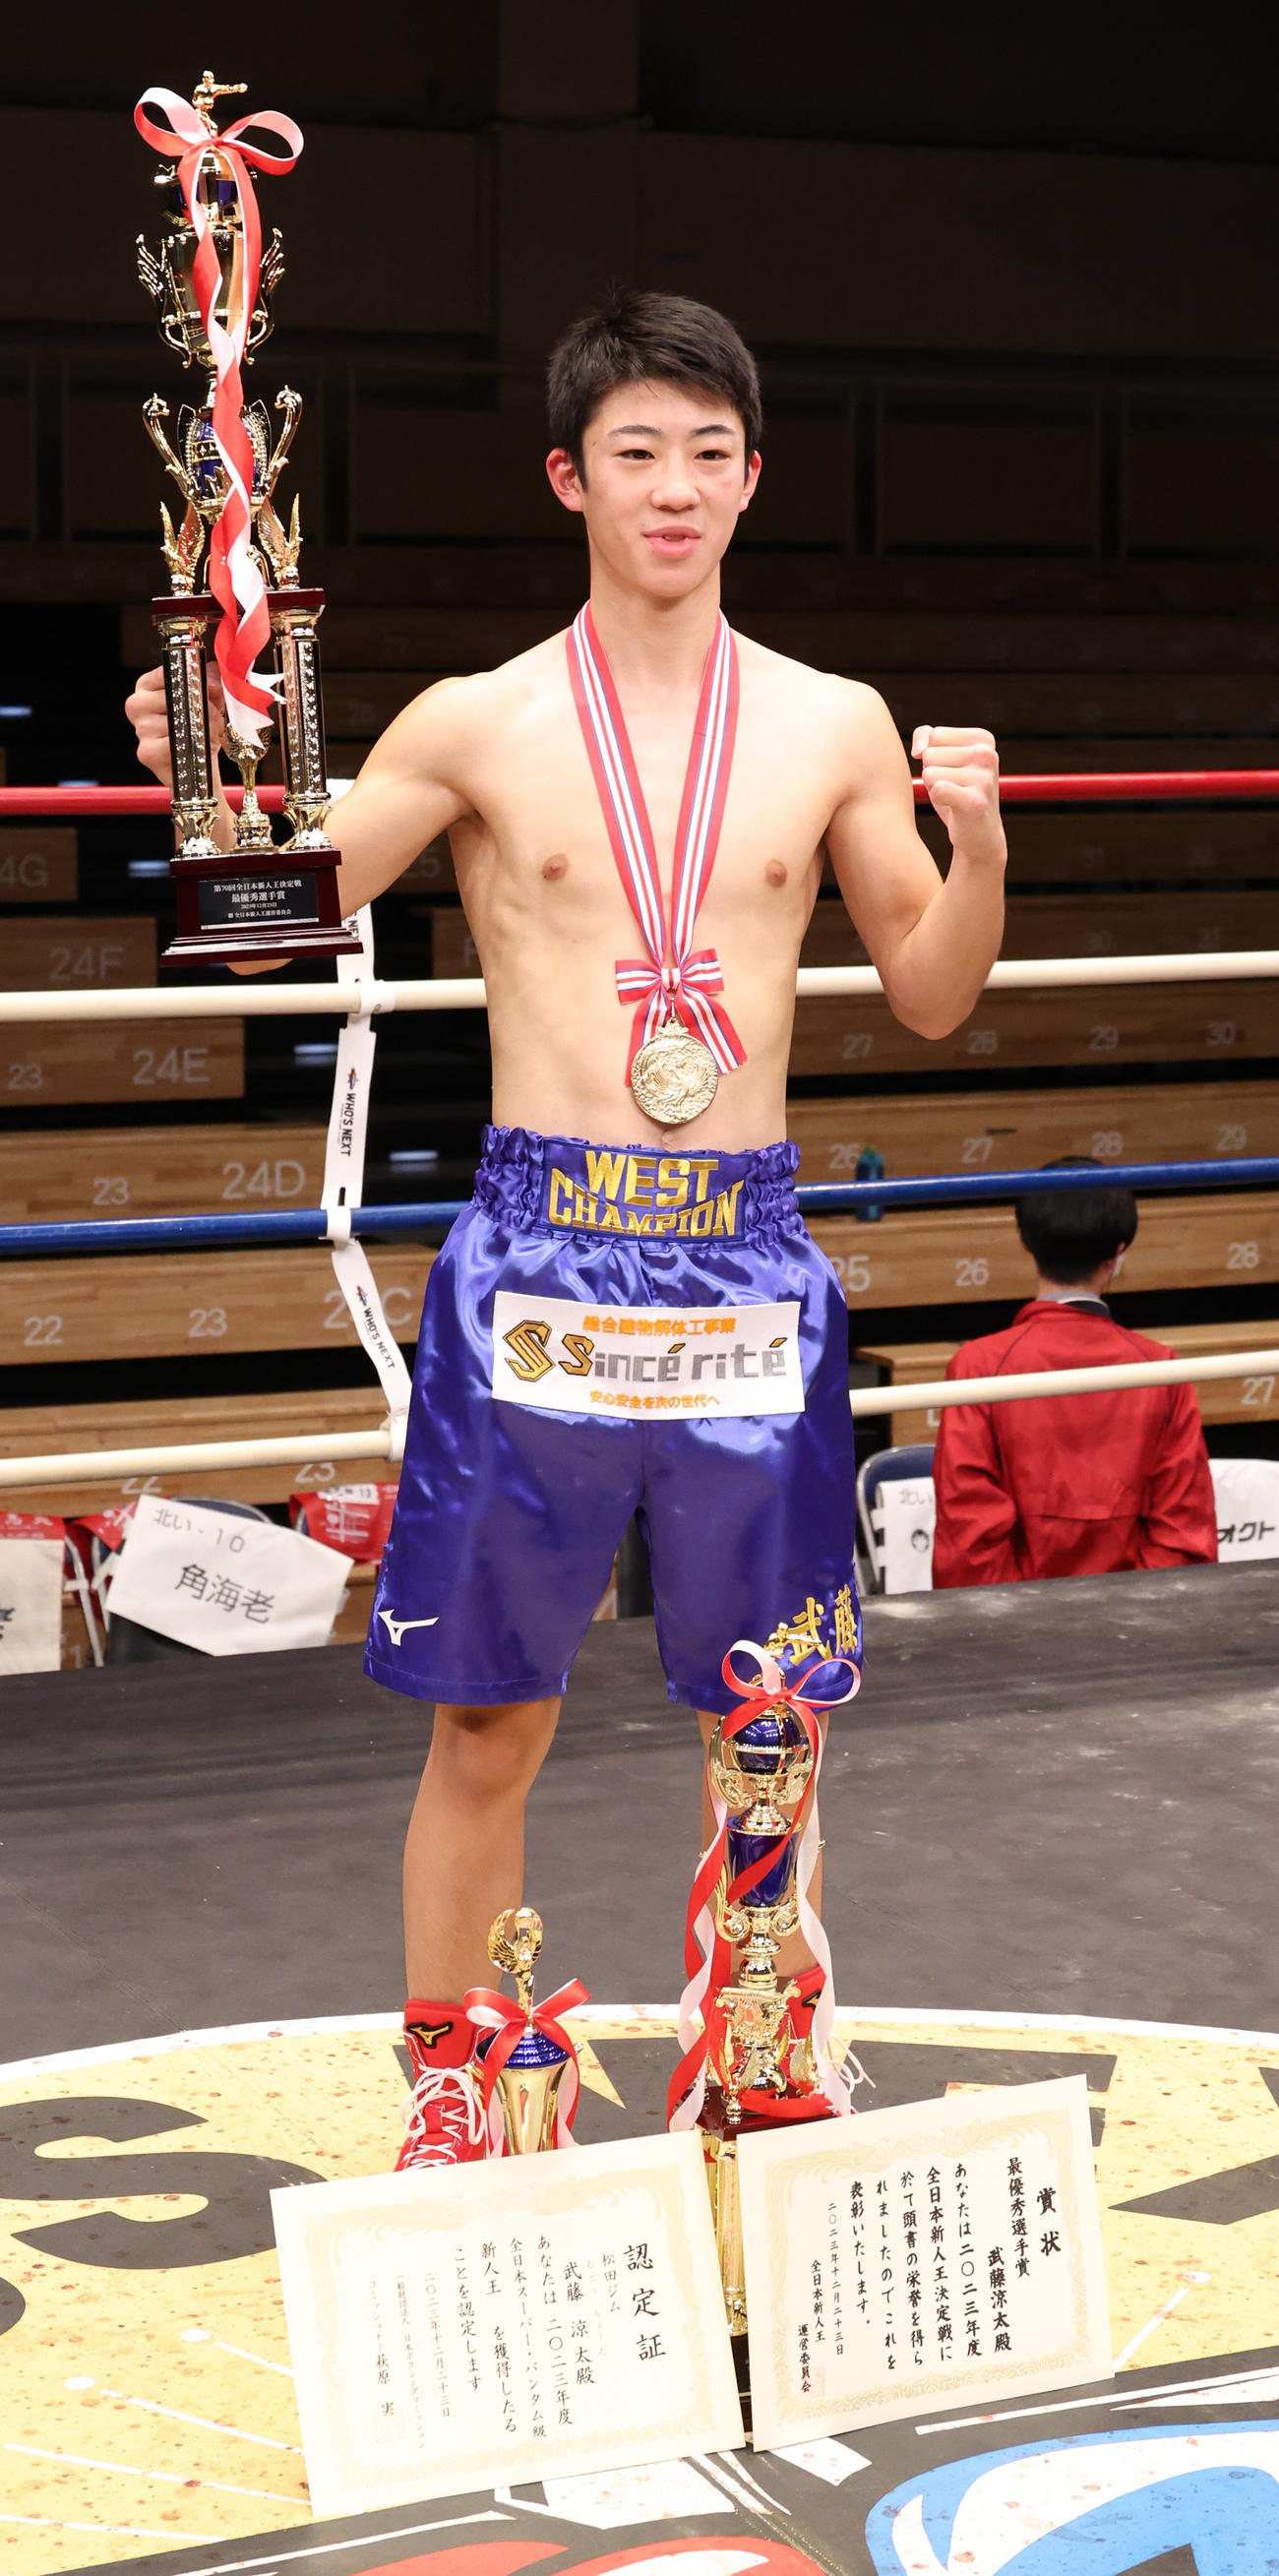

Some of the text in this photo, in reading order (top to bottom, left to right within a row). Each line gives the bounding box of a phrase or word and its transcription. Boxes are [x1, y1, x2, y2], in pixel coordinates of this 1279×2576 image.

[49, 946, 124, 981] 24F
[9, 1064, 43, 1090] 23
[133, 1048, 210, 1084] 24E
[343, 1092, 356, 1127] WHO'S
[339, 1128, 352, 1157] NEXT
[962, 1137, 994, 1163] 27
[1217, 1126, 1247, 1151] 29
[93, 1161, 305, 1206] 23 24D
[548, 1167, 745, 1238] CHAMPION
[585, 1150, 718, 1206] WEST
[955, 1258, 989, 1286] 26
[1227, 1243, 1258, 1270] 28
[25, 1317, 62, 1345] 22
[190, 1309, 227, 1336] 23
[363, 1307, 396, 1369] WHO'S NEXT
[1242, 1377, 1275, 1405] 27
[174, 1564, 274, 1625] 角海老
[1006, 2156, 1031, 2279] 最優秀選手賞
[1037, 2186, 1062, 2257] 賞状
[602, 2253, 621, 2312] 松田ジム
[877, 2179, 897, 2370] れましたのでこれを
[927, 2166, 953, 2361] 全日本新人王決定戦に
[454, 2247, 481, 2392] ことを認定します
[623, 2242, 666, 2361] 認定証
[811, 2259, 826, 2343] 全日本新人王
[987, 2246, 1012, 2354] 武藤涼太殿
